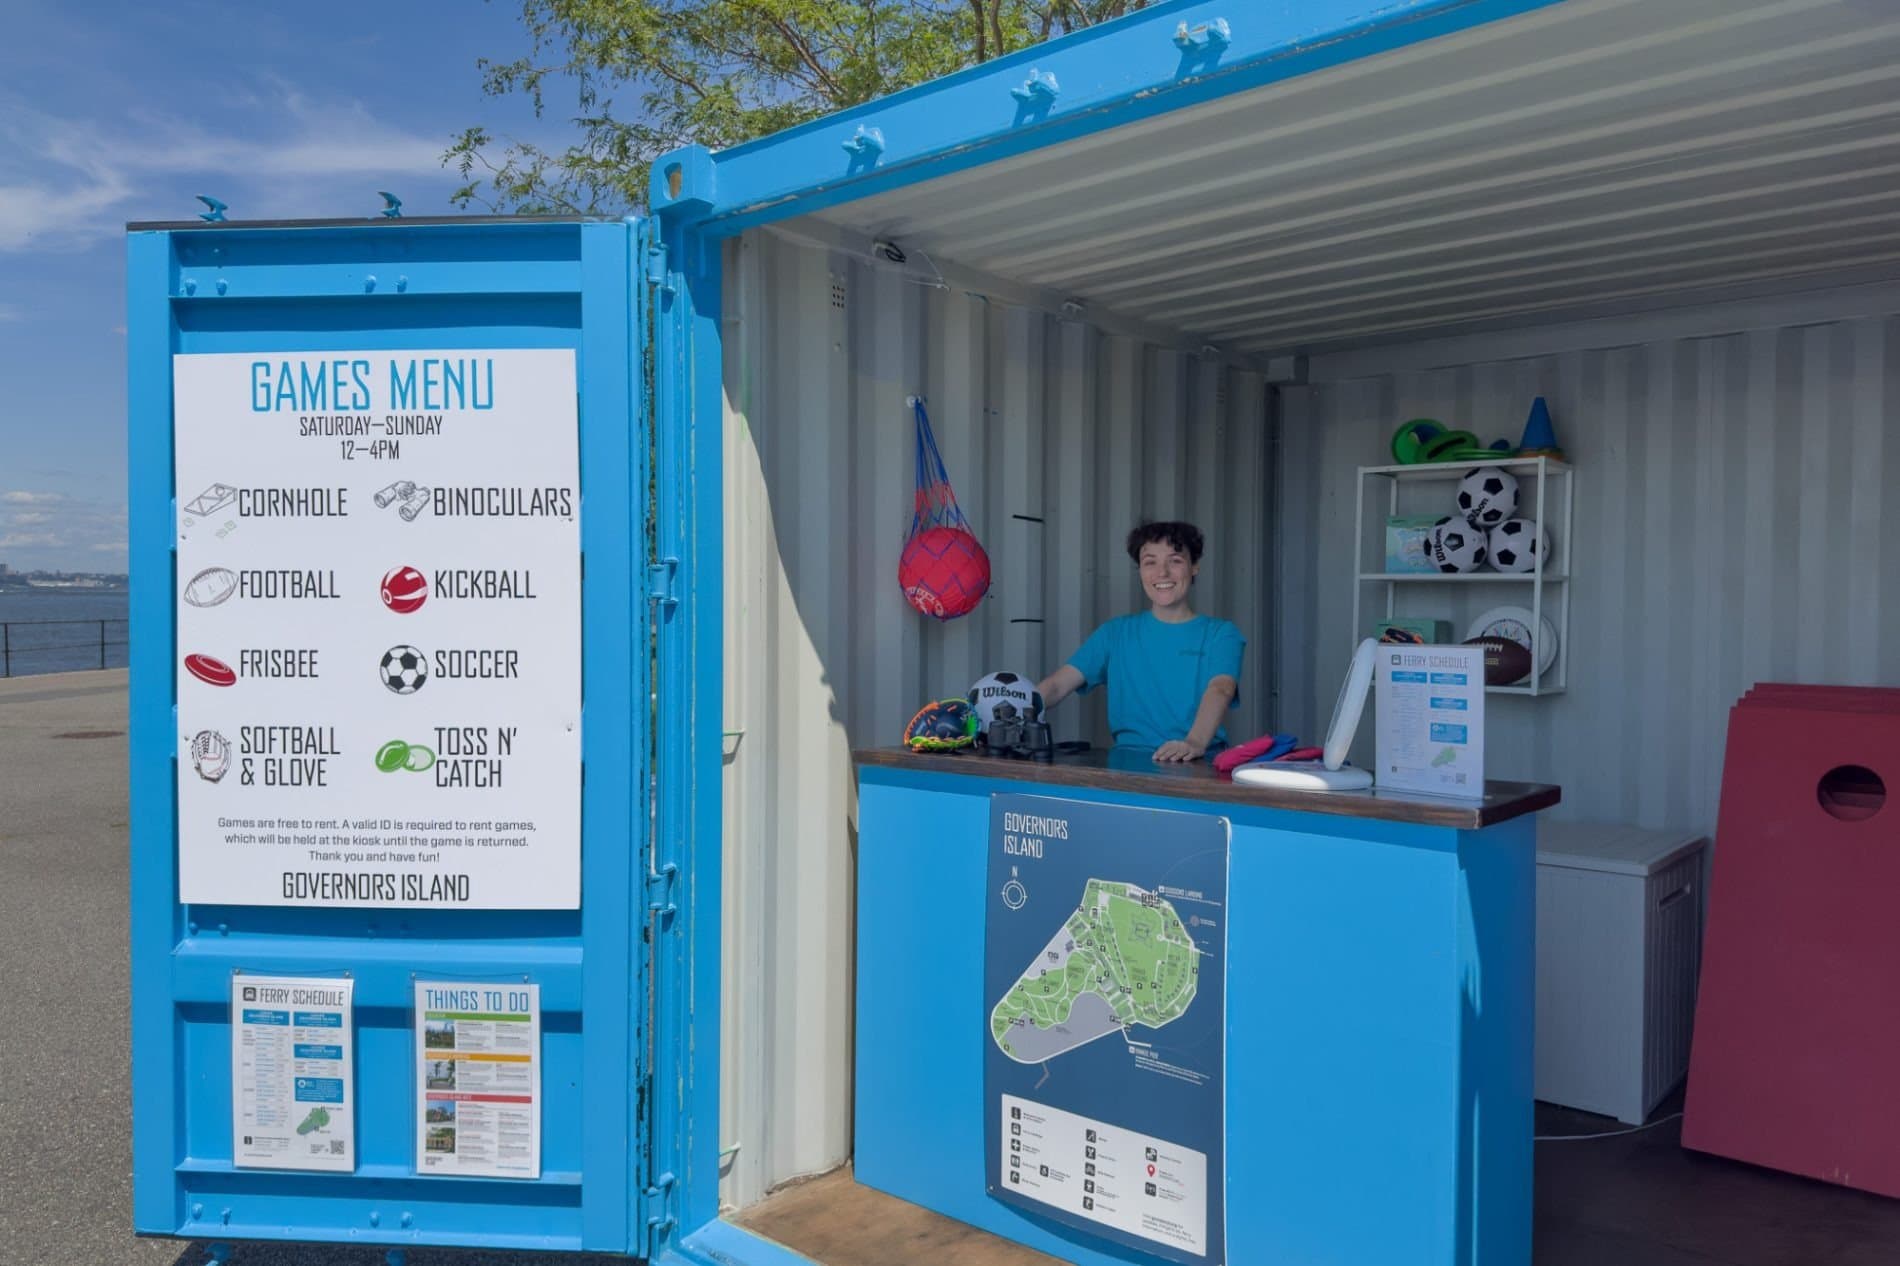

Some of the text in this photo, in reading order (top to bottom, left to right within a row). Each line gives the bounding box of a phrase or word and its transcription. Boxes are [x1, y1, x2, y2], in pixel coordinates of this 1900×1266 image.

[252, 359, 494, 412] GAMES MENU
[239, 488, 348, 517] CORNHOLE
[434, 488, 572, 517] BINOCULARS
[240, 570, 341, 598] FOOTBALL
[435, 570, 536, 598] KICKBALL
[240, 649, 319, 678] FRISBEE
[435, 650, 518, 678] SOCCER
[982, 686, 1026, 700] Wilson
[240, 726, 340, 755] SOFTBALL
[434, 727, 488, 756] TOSS
[241, 758, 327, 787] & GLOVE
[436, 759, 502, 788] CATCH
[218, 817, 537, 832] Games are free to rent. A valid ID is required to rent games,
[1004, 812, 1068, 840] GOVERNORS
[225, 834, 529, 848] which will be held at the kiosk until the game is returned.
[1004, 834, 1043, 858] ISLAND
[309, 850, 440, 863] Thank you and have fun!
[1011, 866, 1018, 877] N
[283, 872, 469, 901] GOVERNORS ISLAND
[260, 988, 344, 1006] FERRY SCHEDULE
[425, 989, 529, 1012] THINGS TO DO
